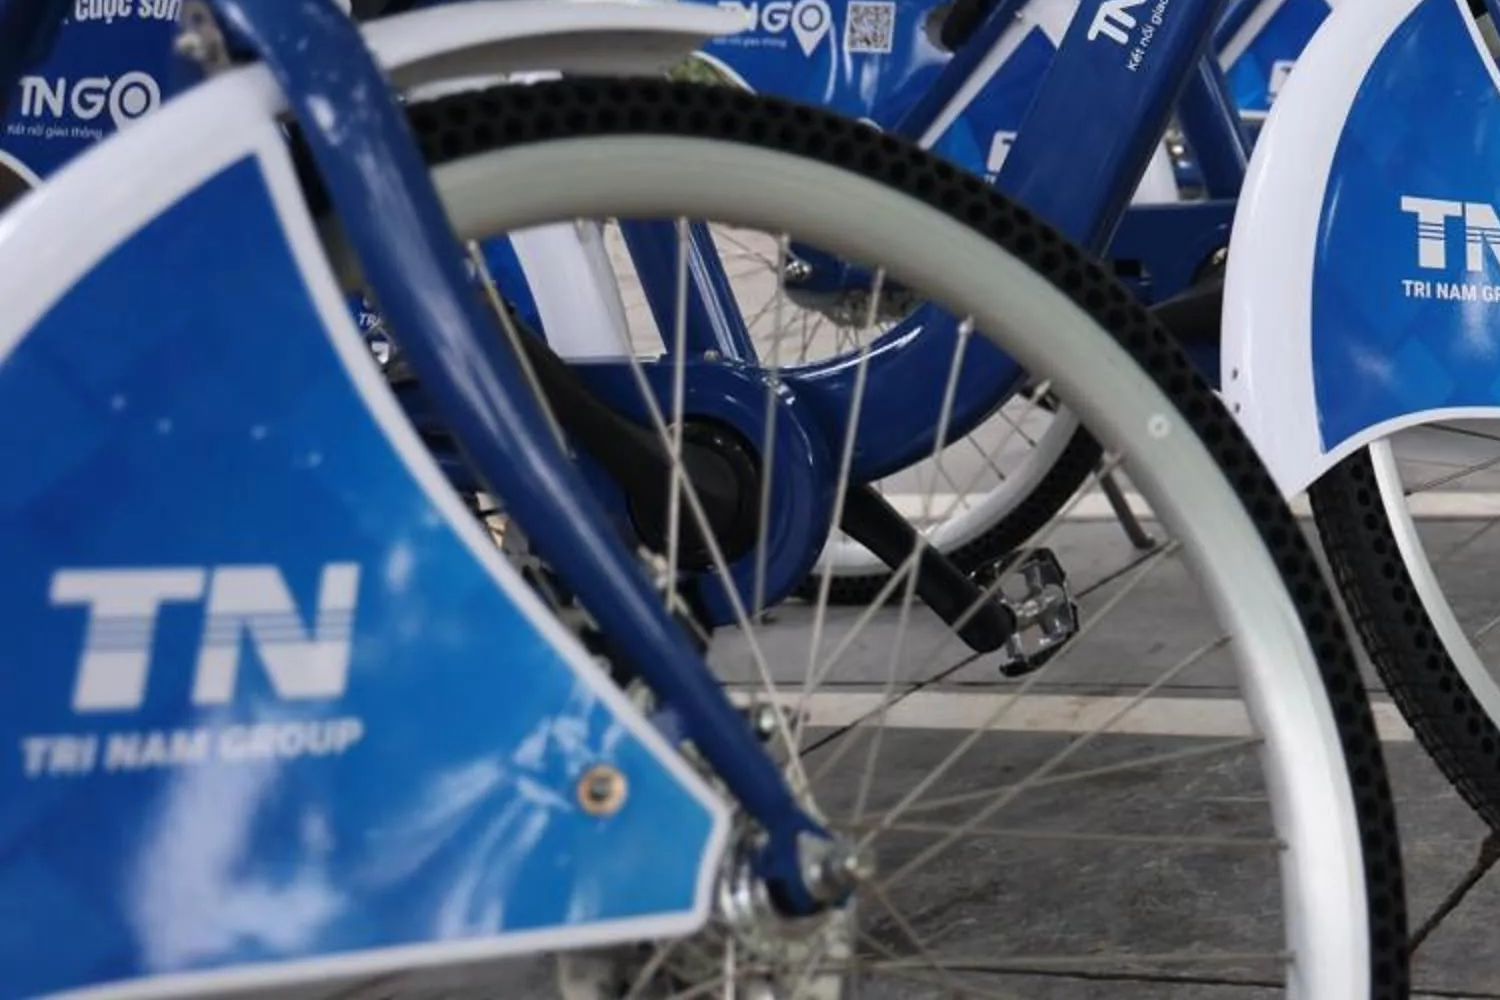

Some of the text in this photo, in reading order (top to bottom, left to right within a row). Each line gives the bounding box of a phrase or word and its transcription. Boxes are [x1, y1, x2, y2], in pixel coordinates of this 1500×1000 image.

[1402, 279, 1431, 298] TRI
[1437, 282, 1477, 302] NAM
[50, 562, 360, 713] TN
[22, 717, 363, 778] TRI NAM GROUP
